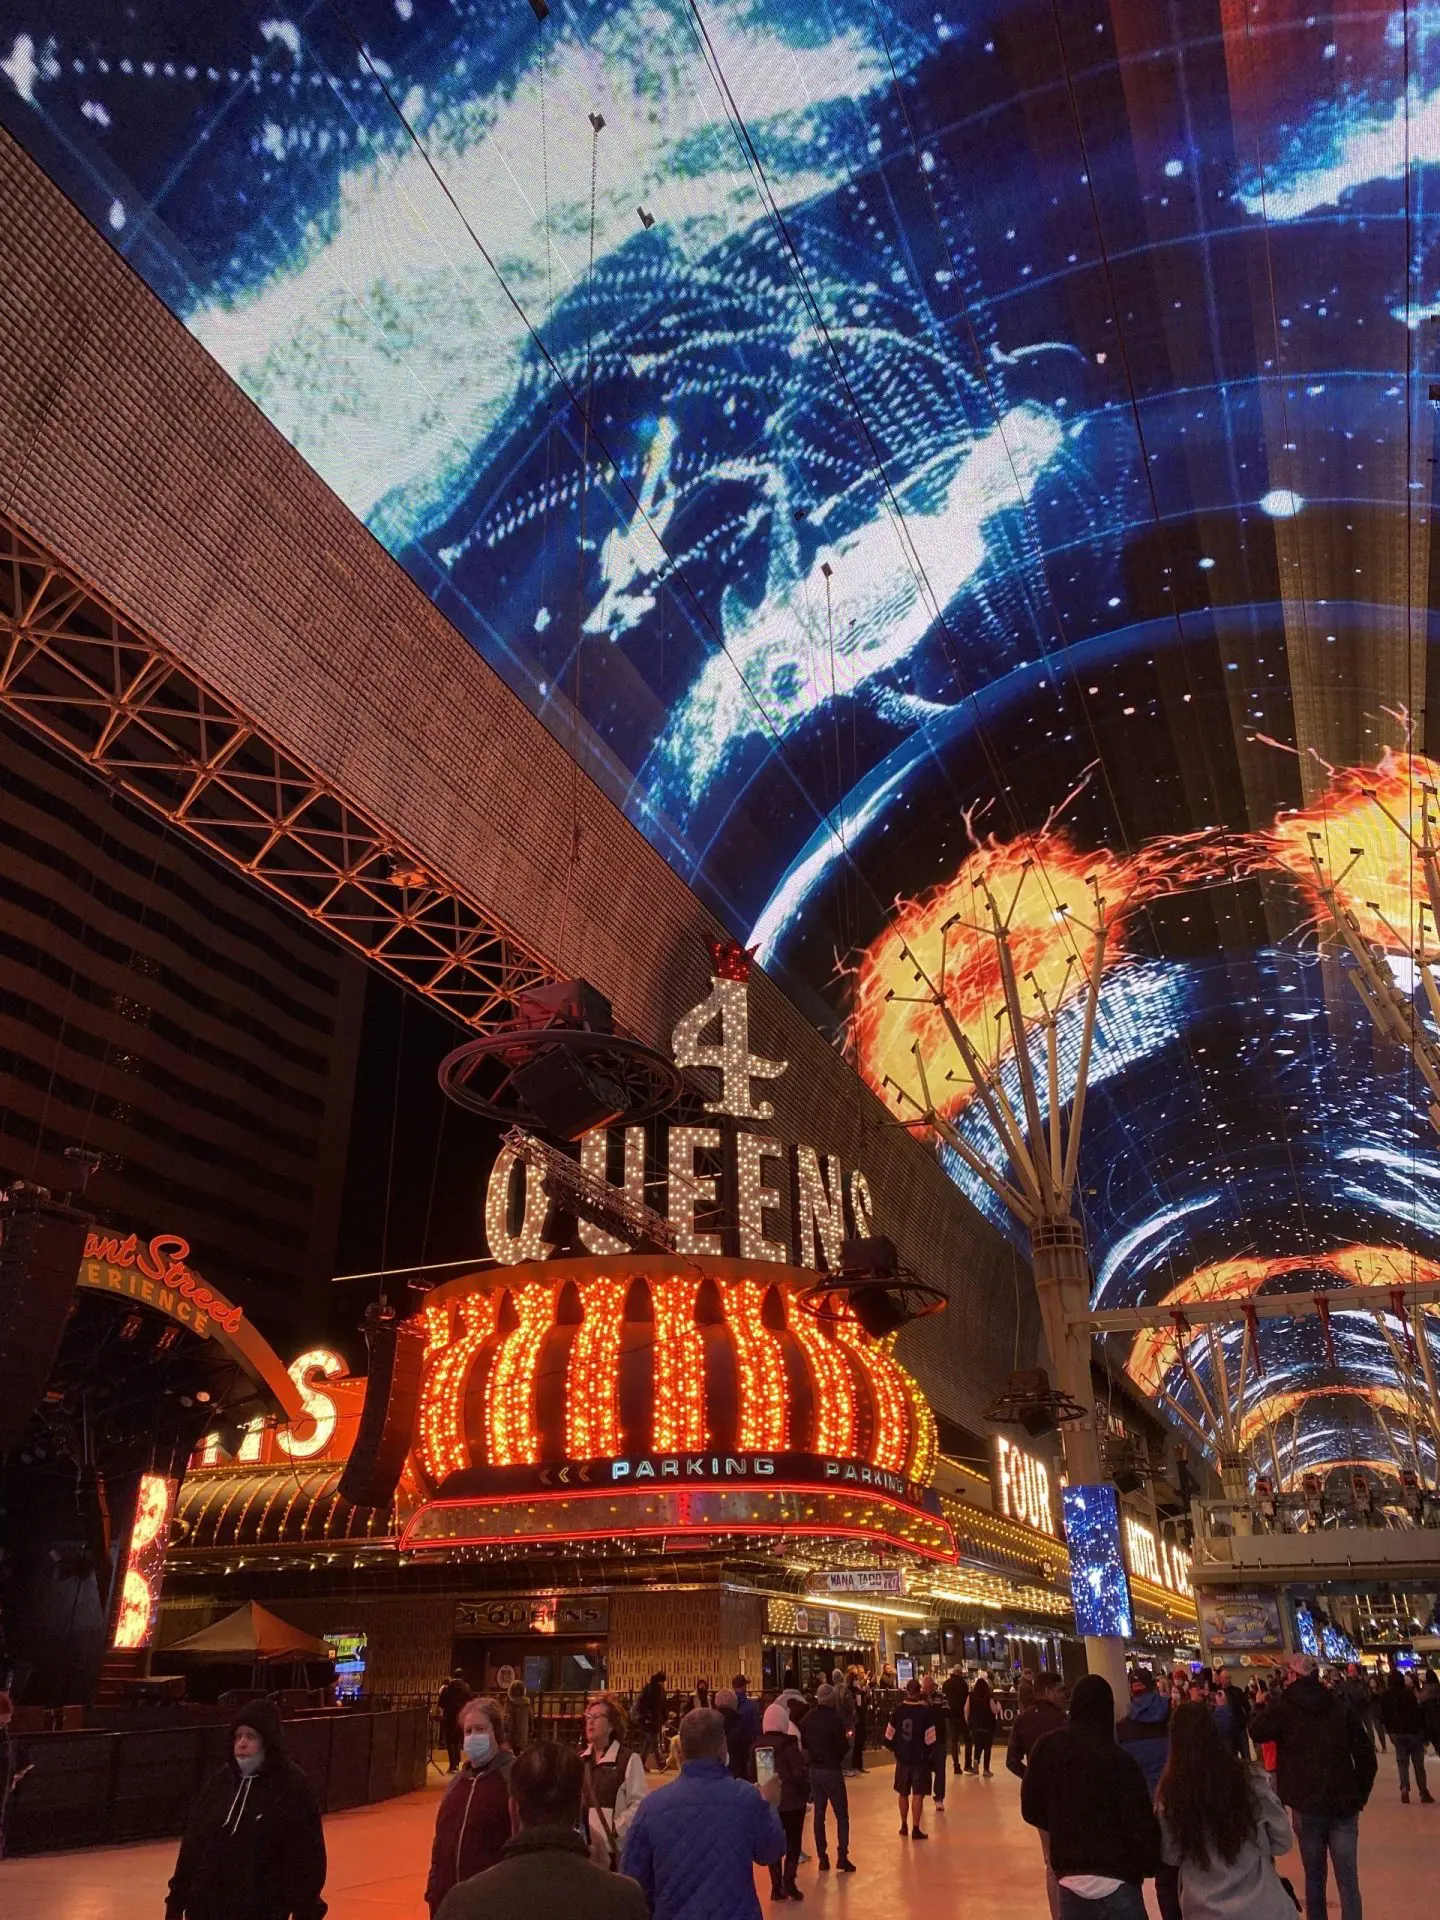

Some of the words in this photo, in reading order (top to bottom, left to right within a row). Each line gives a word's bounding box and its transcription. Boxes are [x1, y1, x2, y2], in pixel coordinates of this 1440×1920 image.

[671, 976, 788, 1120] 4
[486, 1126, 873, 1271] QUEENS
[137, 1234, 243, 1333] Street
[611, 1457, 775, 1480] PARKING
[824, 1461, 904, 1494] PARKING
[997, 1435, 1054, 1535] FOUR
[1125, 1516, 1163, 1585] HOTEL
[830, 1574, 854, 1587] WANA
